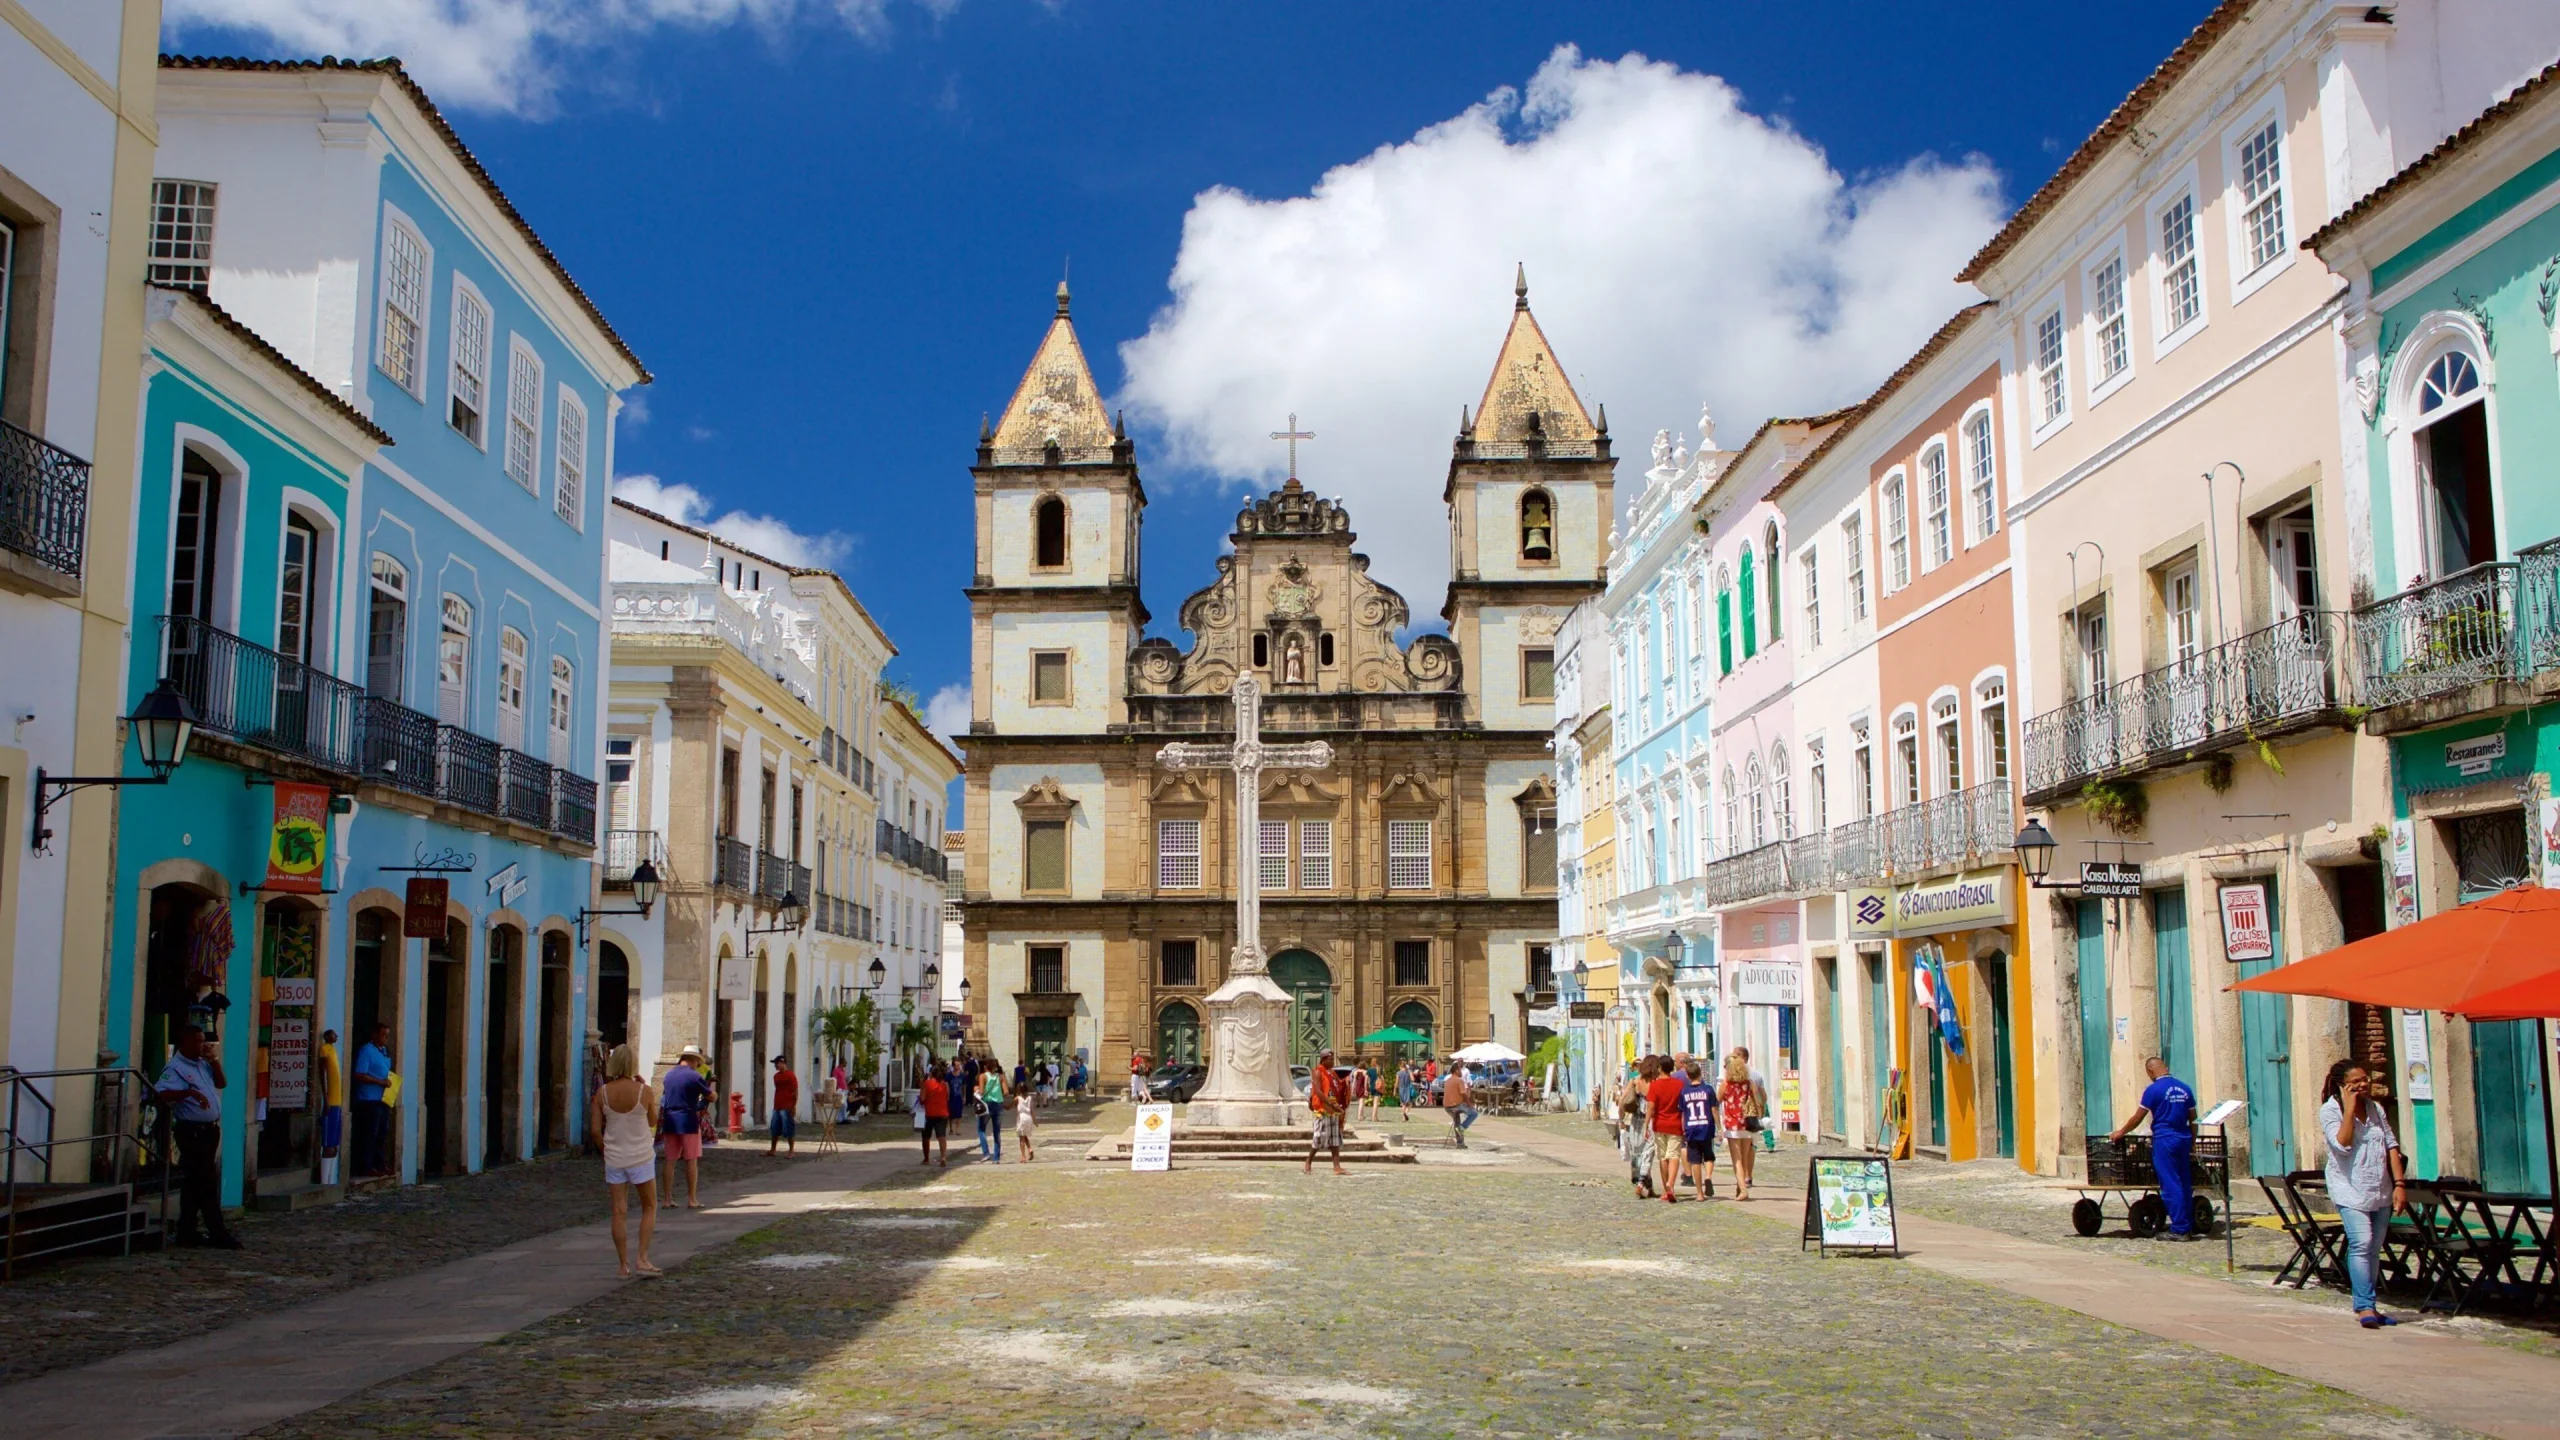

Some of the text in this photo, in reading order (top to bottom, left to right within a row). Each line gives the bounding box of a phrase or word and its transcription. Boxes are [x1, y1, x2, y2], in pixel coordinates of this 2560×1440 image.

[2446, 743, 2497, 764] Restaurante
[2109, 864, 2140, 883] Nossa
[2082, 884, 2140, 895] GALERIA DE ARTE
[1912, 893, 1943, 916] BANCO
[1958, 883, 1995, 909] BRASIL
[2230, 929, 2267, 942] COLISEU
[2229, 941, 2270, 954] RESTAURANTE
[1744, 969, 1796, 986] ADVOCATUS
[1781, 989, 1796, 999] DEI
[1687, 1101, 1707, 1121] 11
